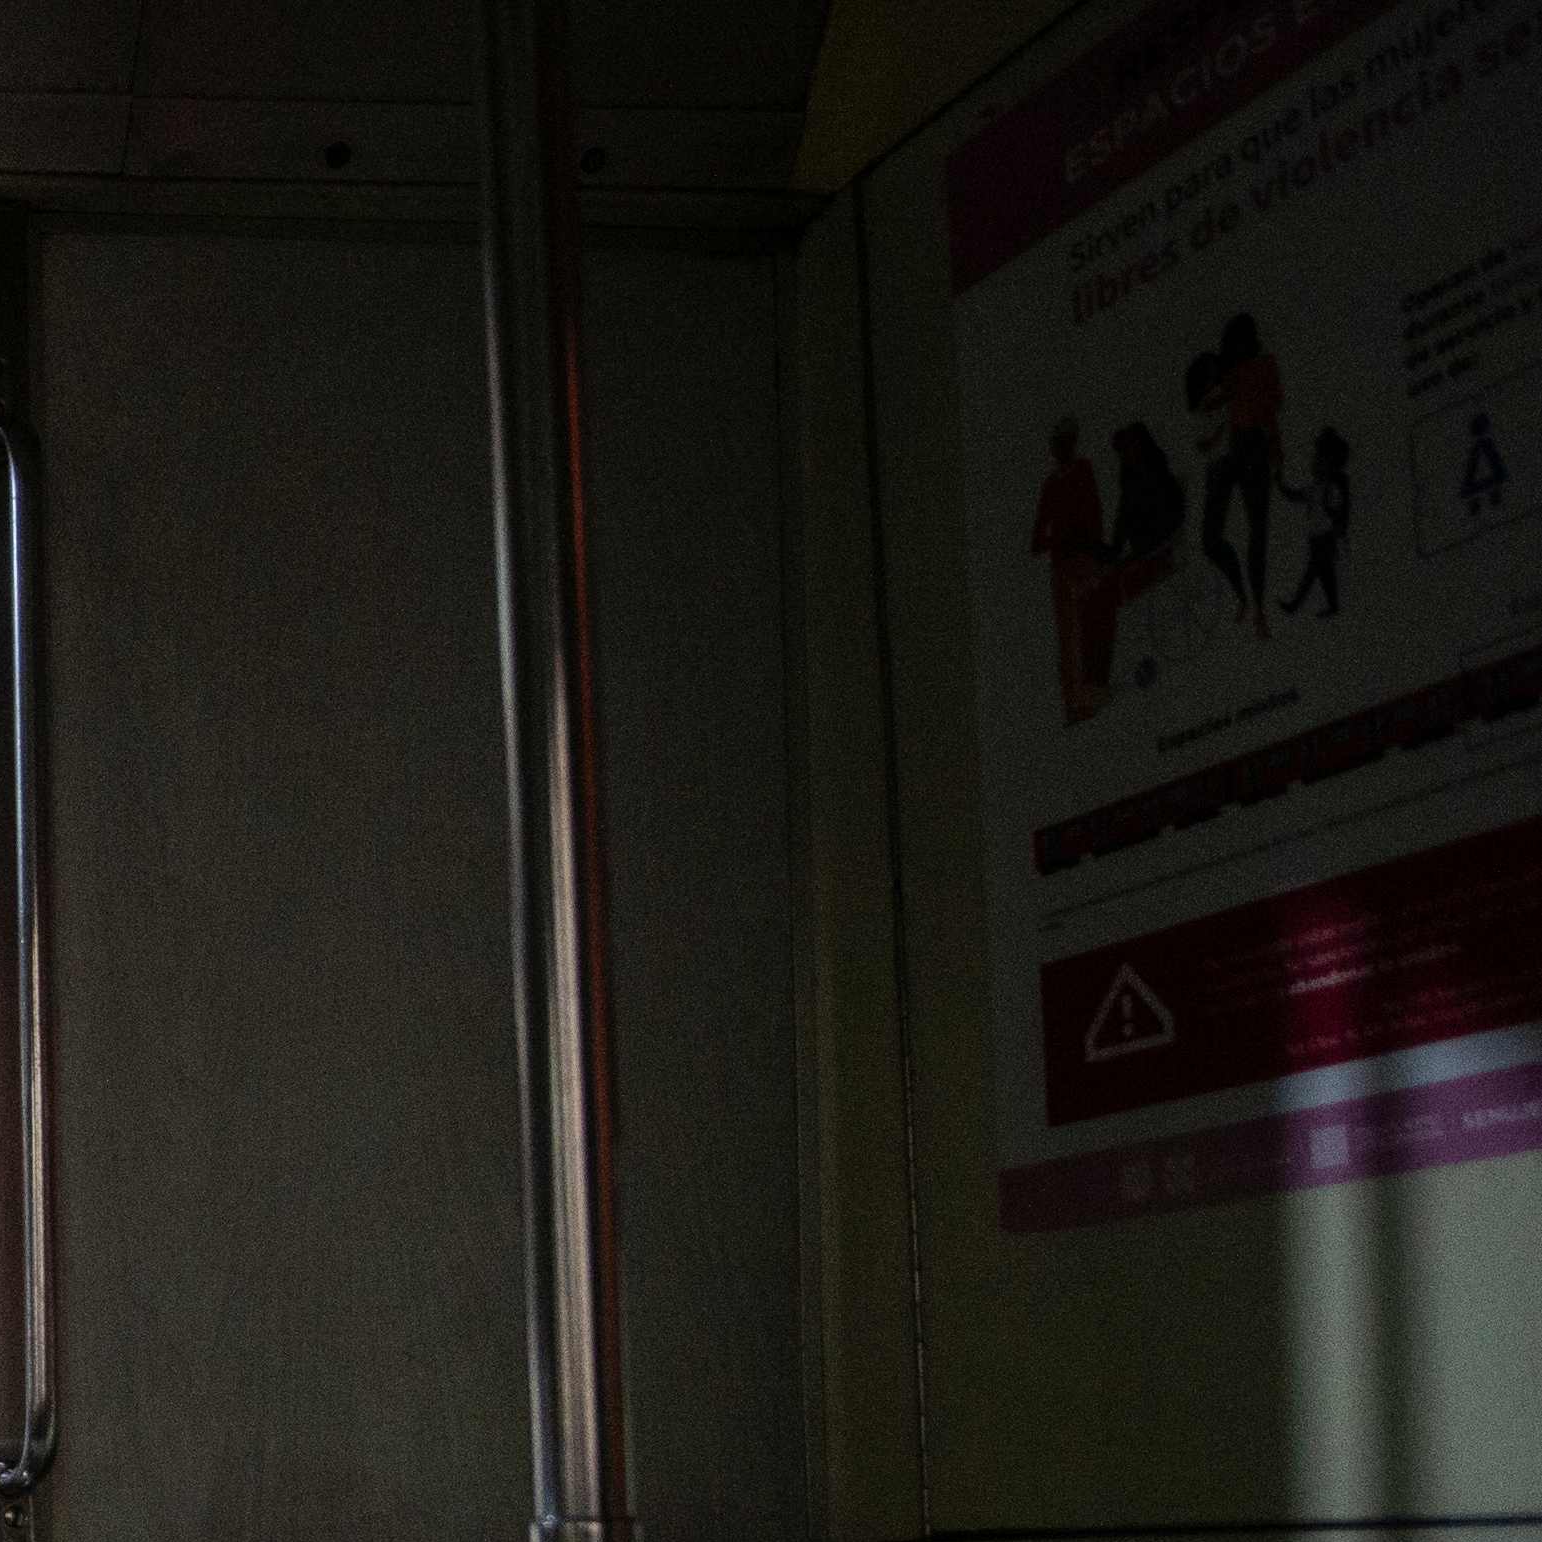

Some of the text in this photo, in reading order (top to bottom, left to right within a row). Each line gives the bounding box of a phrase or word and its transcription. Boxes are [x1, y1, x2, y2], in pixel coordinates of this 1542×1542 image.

[1065, 12, 1277, 183] ESPACIOS
[1070, 202, 1156, 271] Sirven
[1166, 154, 1232, 218] para
[1241, 107, 1301, 164] que
[1310, 71, 1357, 119] las
[1071, 240, 1179, 323] libres
[1190, 203, 1239, 249] de
[1249, 65, 1462, 211] violencia
